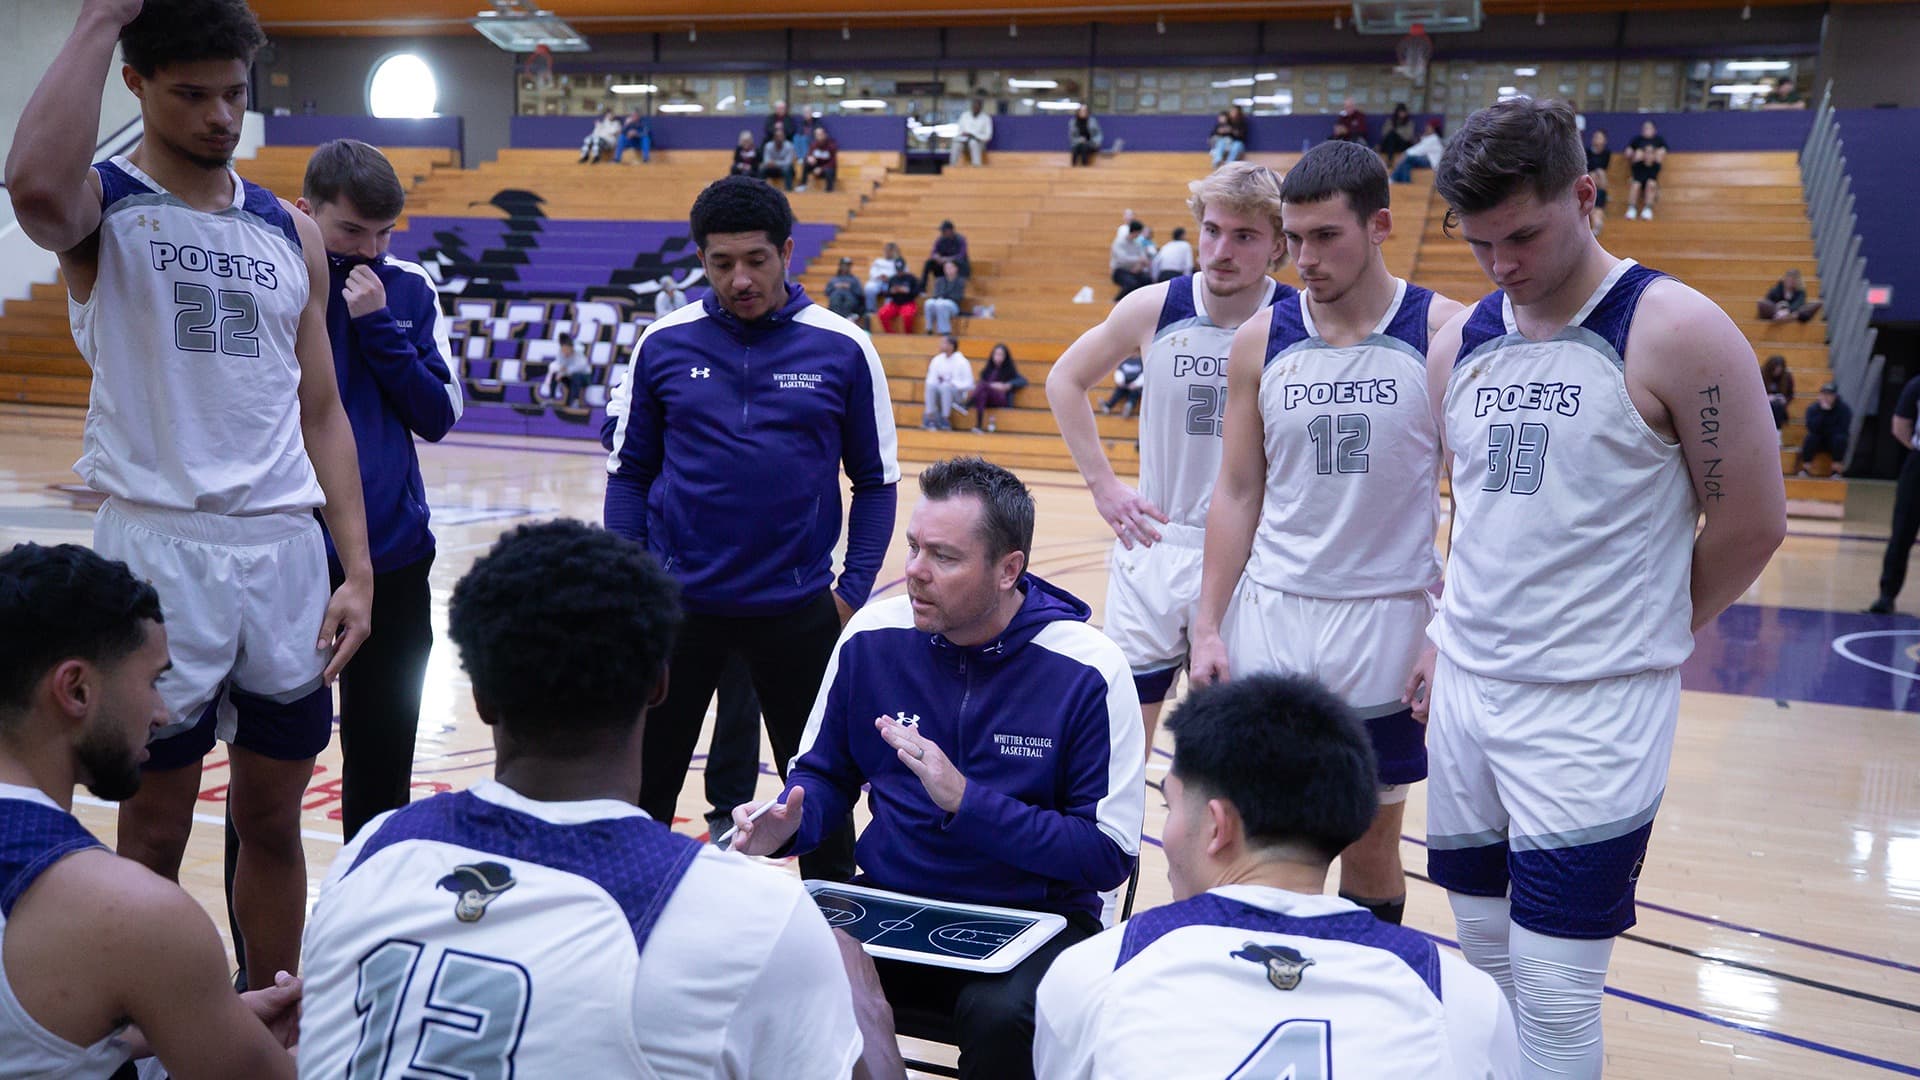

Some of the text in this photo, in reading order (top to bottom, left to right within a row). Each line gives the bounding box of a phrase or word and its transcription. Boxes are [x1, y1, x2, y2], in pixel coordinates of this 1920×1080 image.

[150, 240, 278, 291] POETS
[174, 281, 260, 358] 22
[780, 381, 815, 389] BASKETBALL
[799, 373, 822, 382] COLLEGE
[1284, 379, 1398, 411] POETS
[1474, 382, 1582, 418] POETS
[1307, 413, 1371, 475] 12
[1482, 422, 1550, 496] 33
[1699, 384, 1725, 502] Fear Not
[993, 733, 1053, 748] WHITTIER COLLEGE
[1000, 744, 1044, 758] BASKETBALL
[346, 938, 532, 1080] 13
